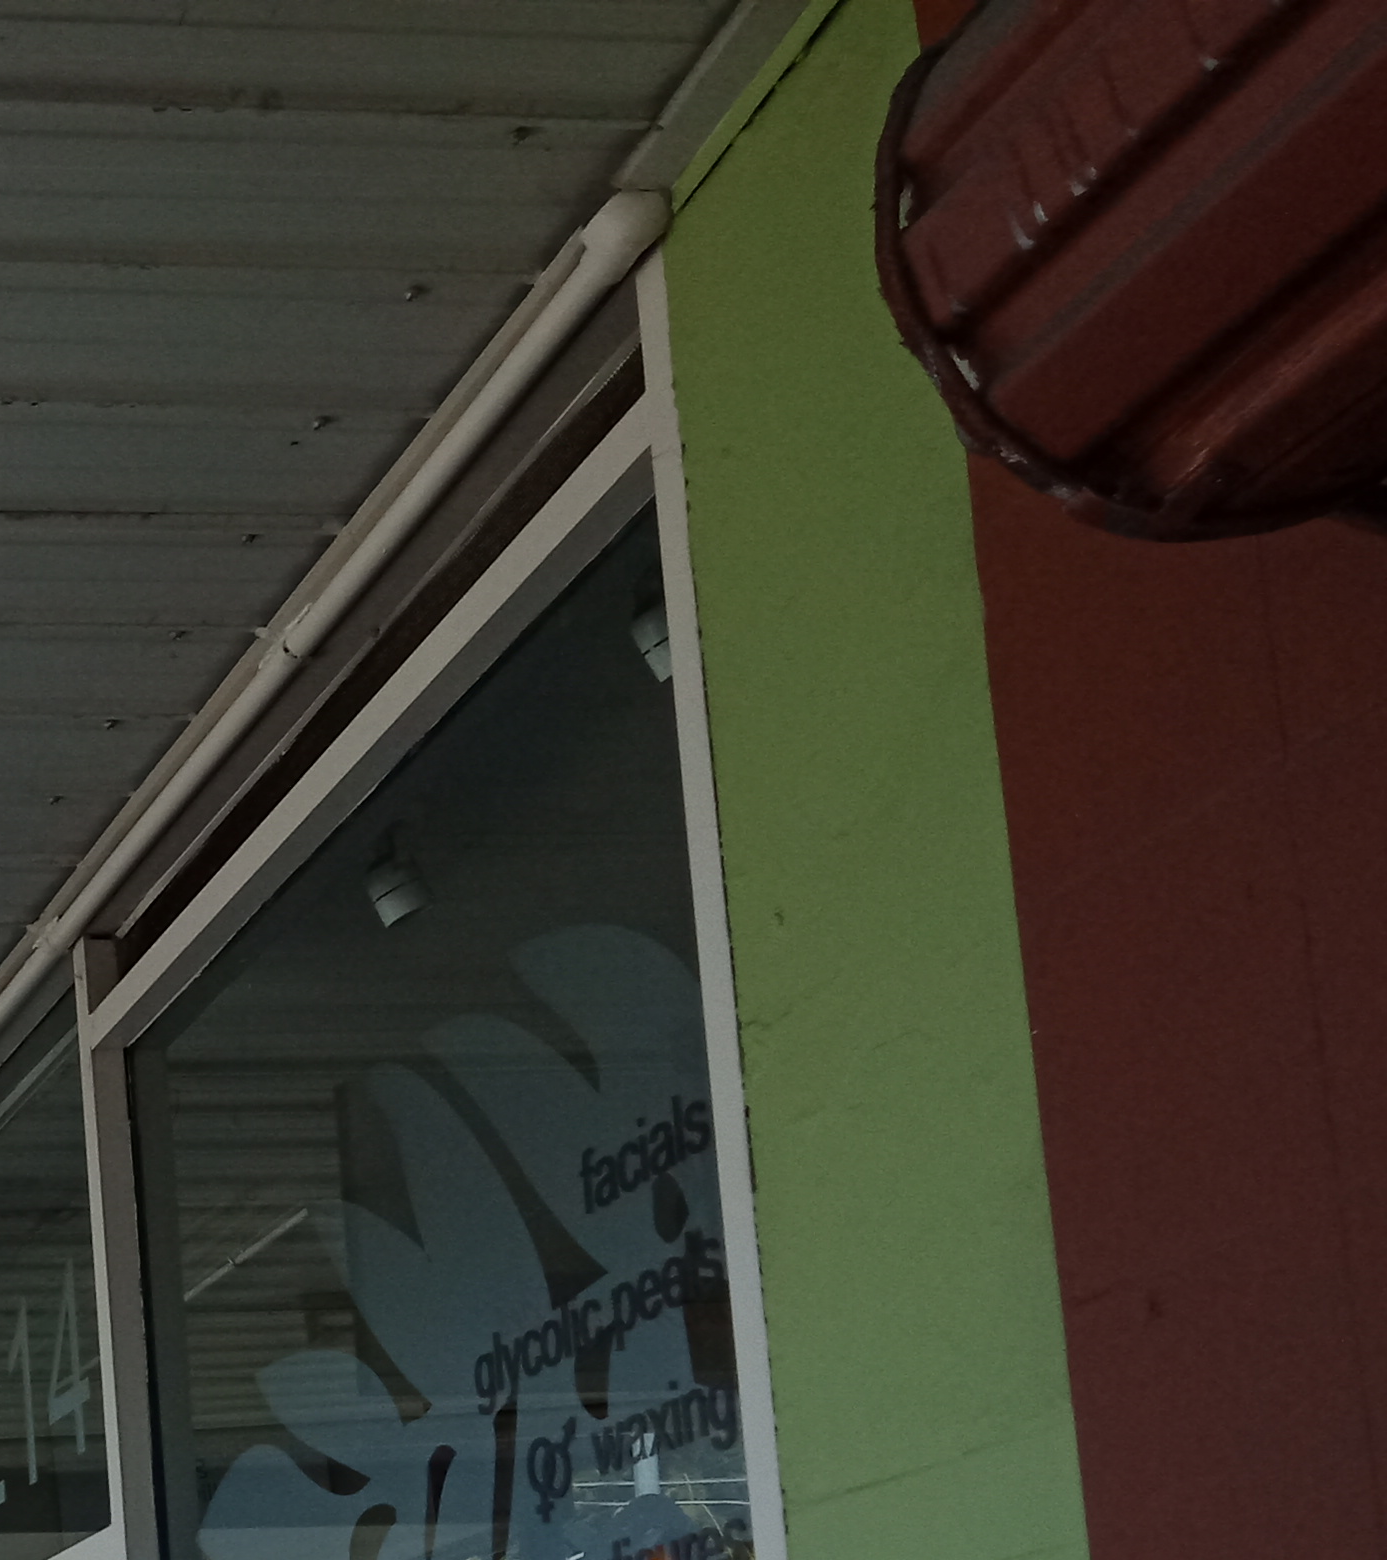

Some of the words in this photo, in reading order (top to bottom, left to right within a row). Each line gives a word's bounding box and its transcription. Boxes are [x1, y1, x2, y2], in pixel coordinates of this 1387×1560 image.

[577, 1093, 711, 1215] facials
[473, 1296, 608, 1415] glycolic
[611, 1230, 727, 1351] peels
[590, 1380, 740, 1475] waxing
